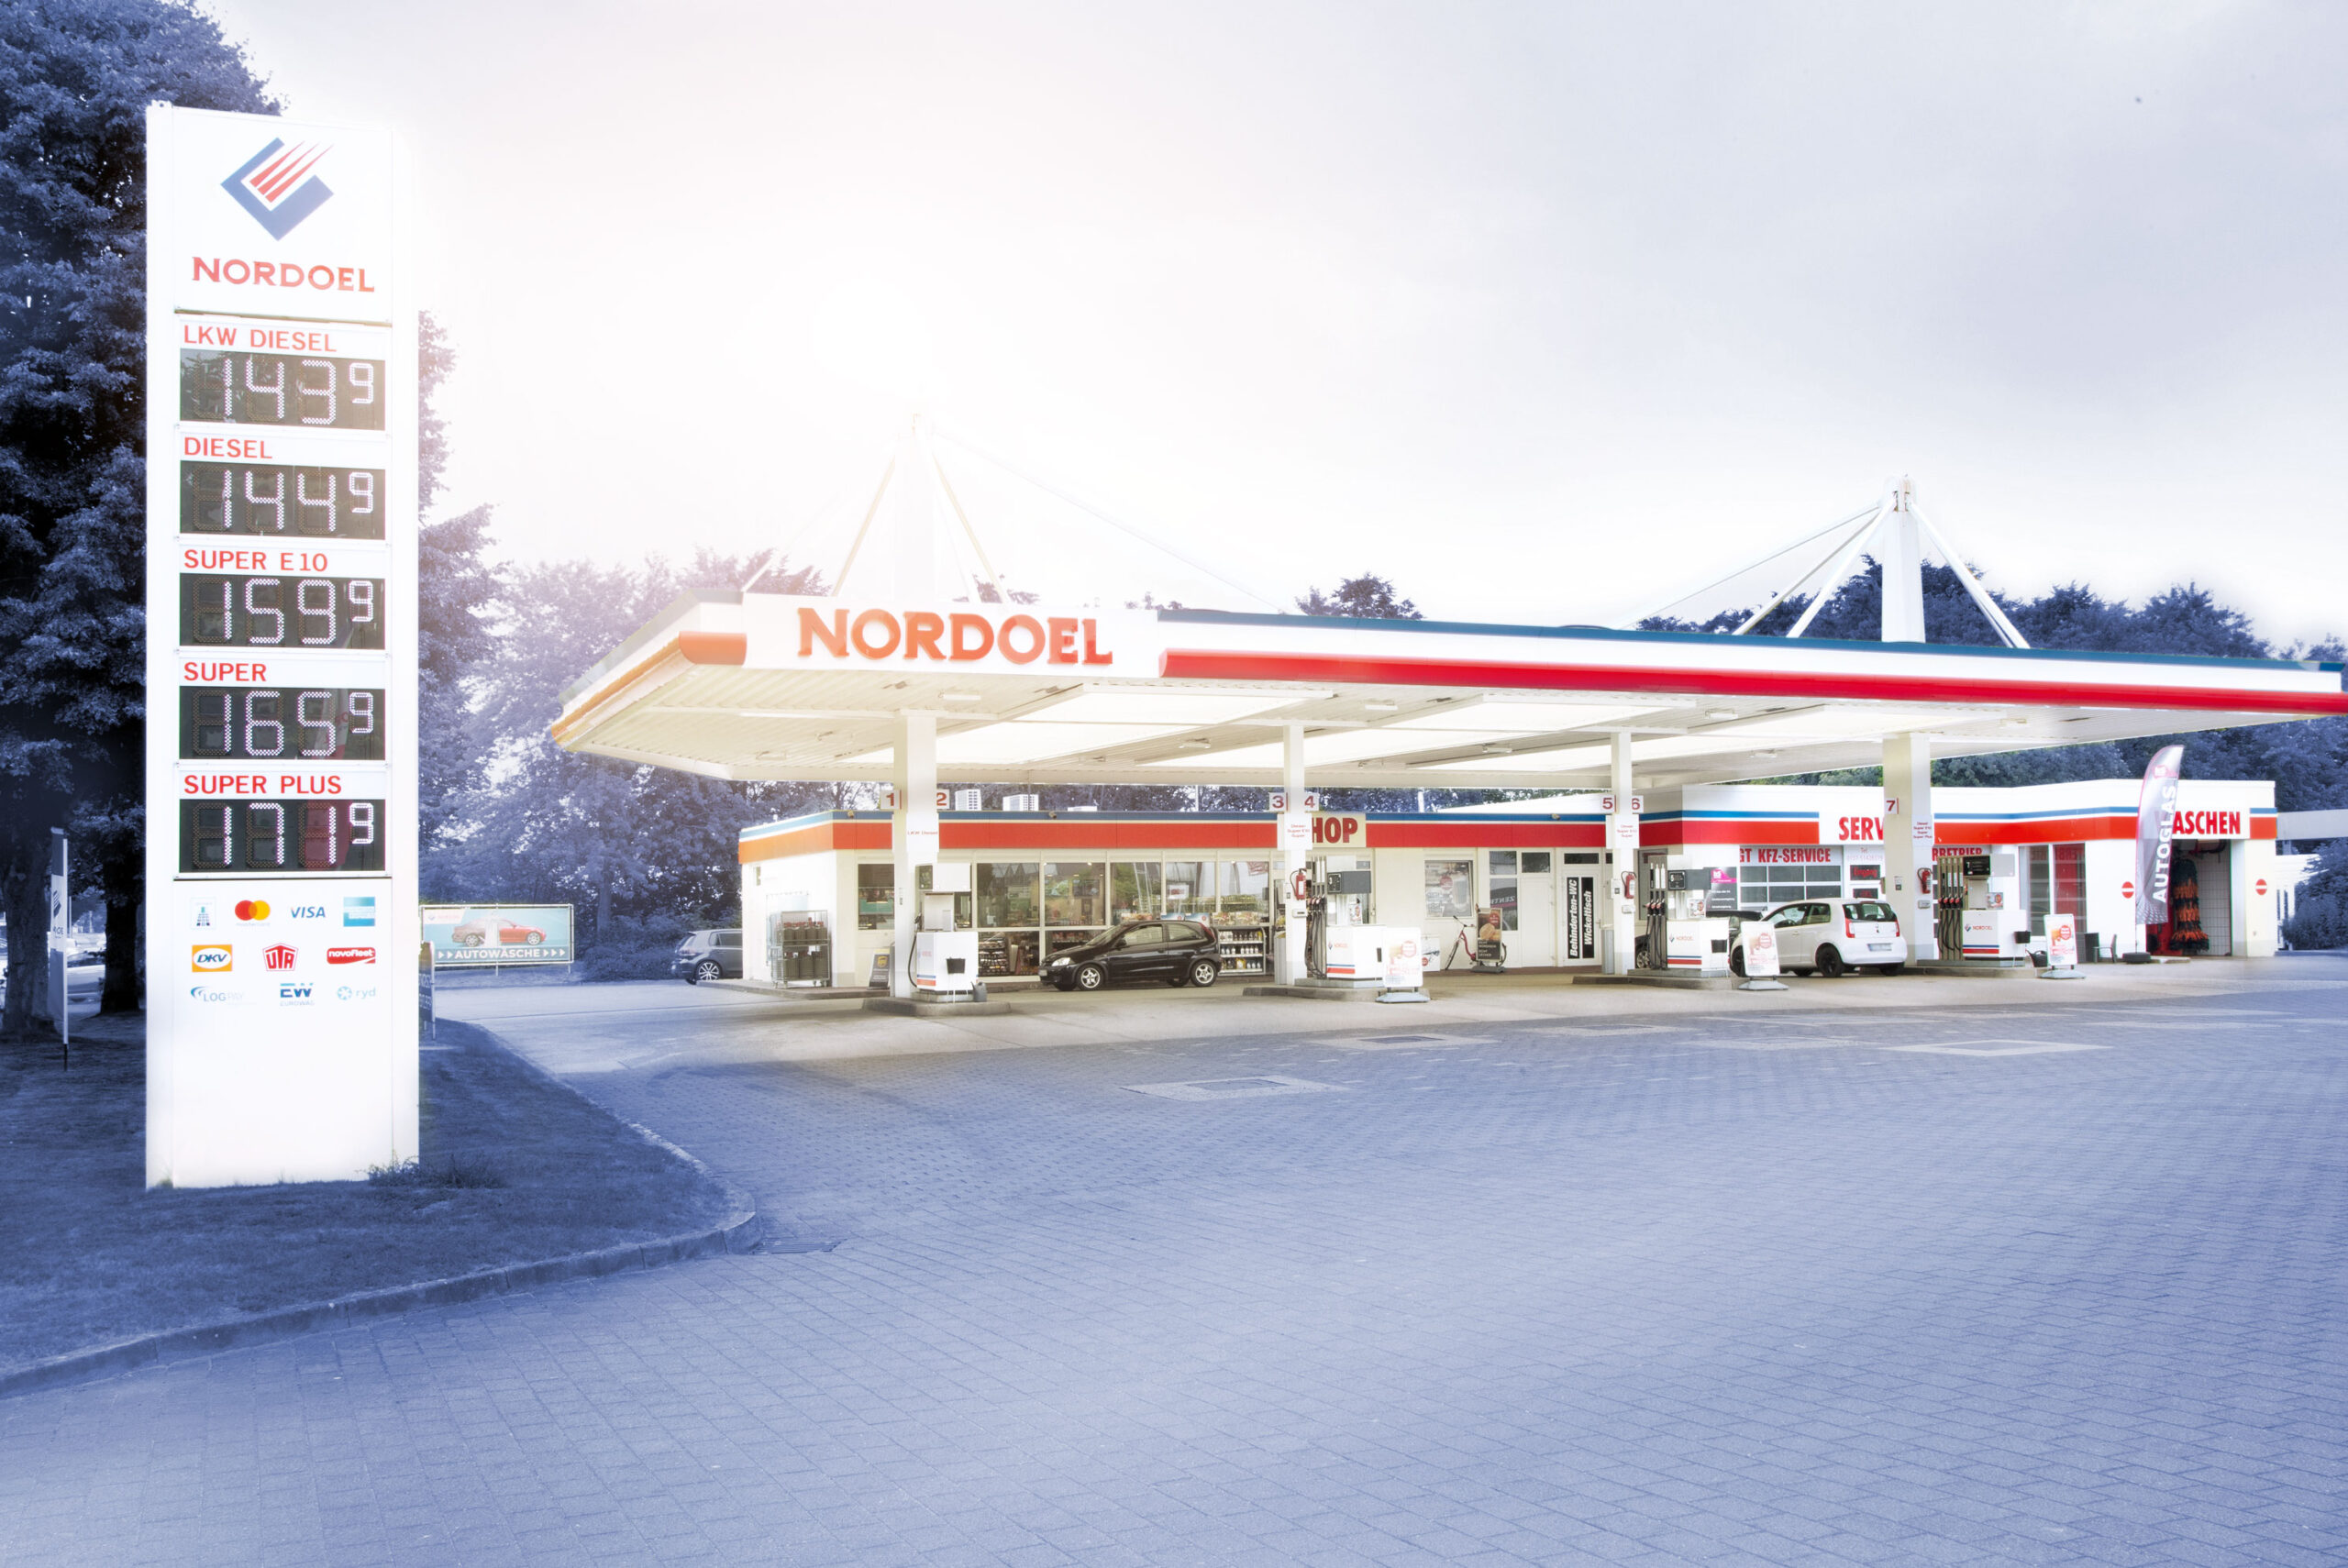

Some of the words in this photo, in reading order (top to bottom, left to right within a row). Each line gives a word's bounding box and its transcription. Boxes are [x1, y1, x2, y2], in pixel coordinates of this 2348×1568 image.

[192, 256, 376, 293] NORDOEL
[183, 325, 238, 347] LKW
[249, 328, 337, 352] DIESEL
[183, 436, 273, 459] DIESEL
[183, 548, 268, 570] SUPER
[797, 607, 1113, 666] NORDOEL
[183, 661, 268, 682] SUPER
[183, 774, 268, 795] SUPER
[280, 775, 342, 795] PLUS
[886, 792, 894, 806] 1
[936, 792, 947, 807] 2
[1272, 796, 1283, 808] 3
[1304, 796, 1315, 808] 4
[1602, 798, 1612, 809] 5
[1632, 798, 1640, 810] 6
[1886, 800, 1895, 812] 7
[2172, 811, 2241, 835] ASCHEN
[2153, 785, 2176, 903] AUTOGLAS
[1758, 848, 1831, 864] KFZ-SERVICE
[290, 906, 326, 919] VISA
[1568, 878, 1578, 957] Behinderten-WC
[1583, 889, 1593, 945] Wickeltisch
[196, 954, 228, 963] DKV
[355, 986, 376, 999] ryd
